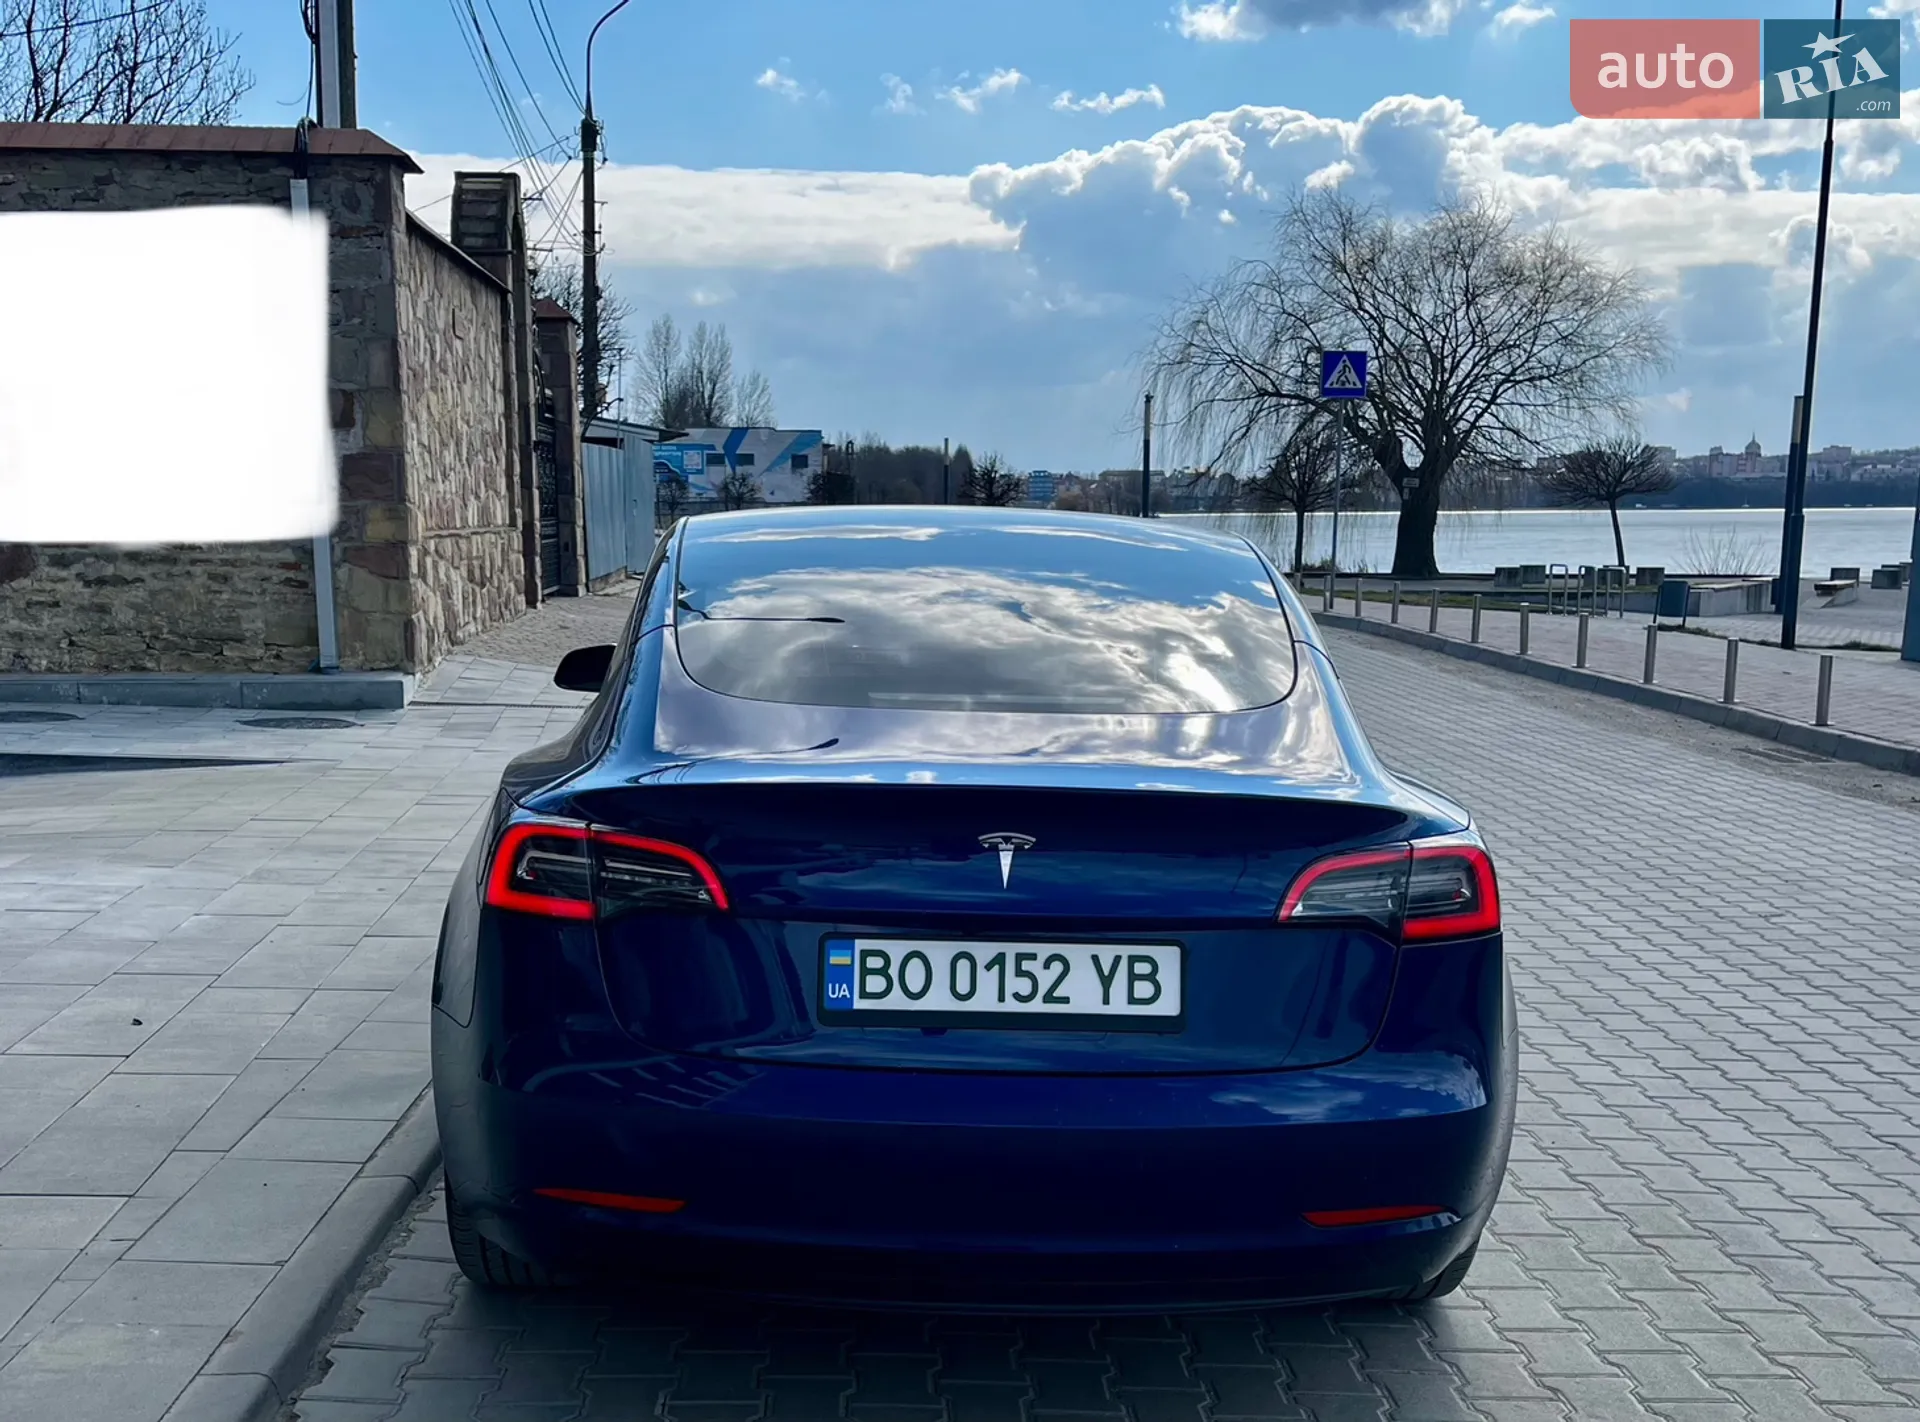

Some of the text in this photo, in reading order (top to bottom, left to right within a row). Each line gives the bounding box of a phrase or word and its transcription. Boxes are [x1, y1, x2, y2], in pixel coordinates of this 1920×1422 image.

[828, 983, 850, 998] UA
[858, 949, 1162, 1006] BO 0152 YB
